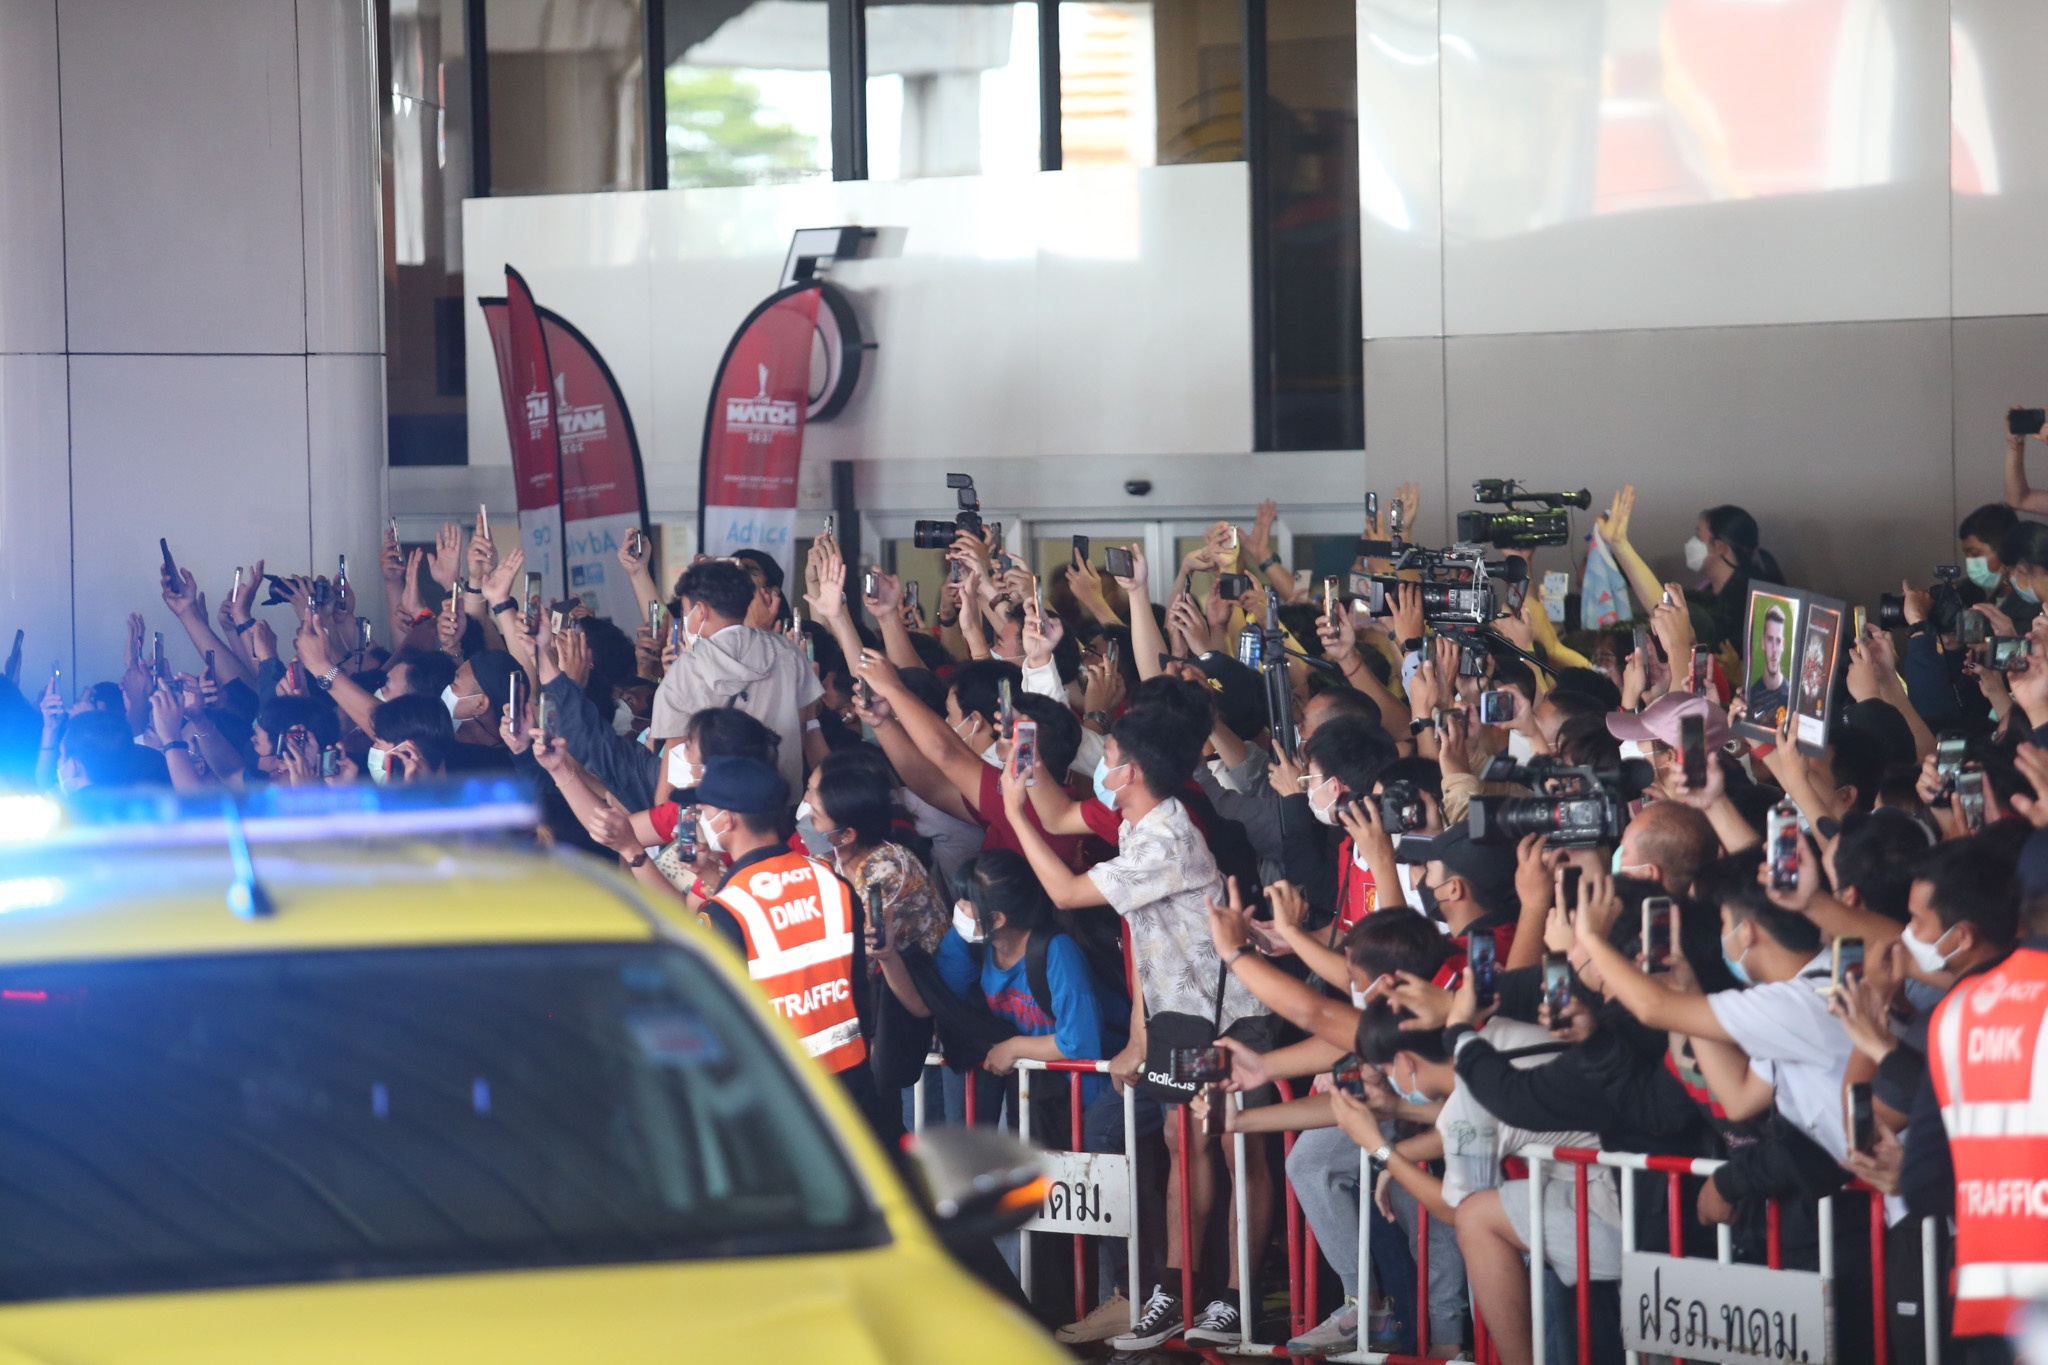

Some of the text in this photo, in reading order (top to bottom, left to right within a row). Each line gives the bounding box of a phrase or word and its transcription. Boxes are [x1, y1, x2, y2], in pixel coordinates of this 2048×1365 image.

[727, 404, 798, 425] MATCH
[727, 520, 788, 545] Adice
[781, 867, 814, 885] AOT
[769, 895, 822, 930] DMK
[769, 978, 850, 1018] TRAFFIC
[2001, 980, 2046, 1001] AOT
[1967, 1026, 2024, 1064] DMK
[1958, 1178, 2048, 1218] TRAFFIC
